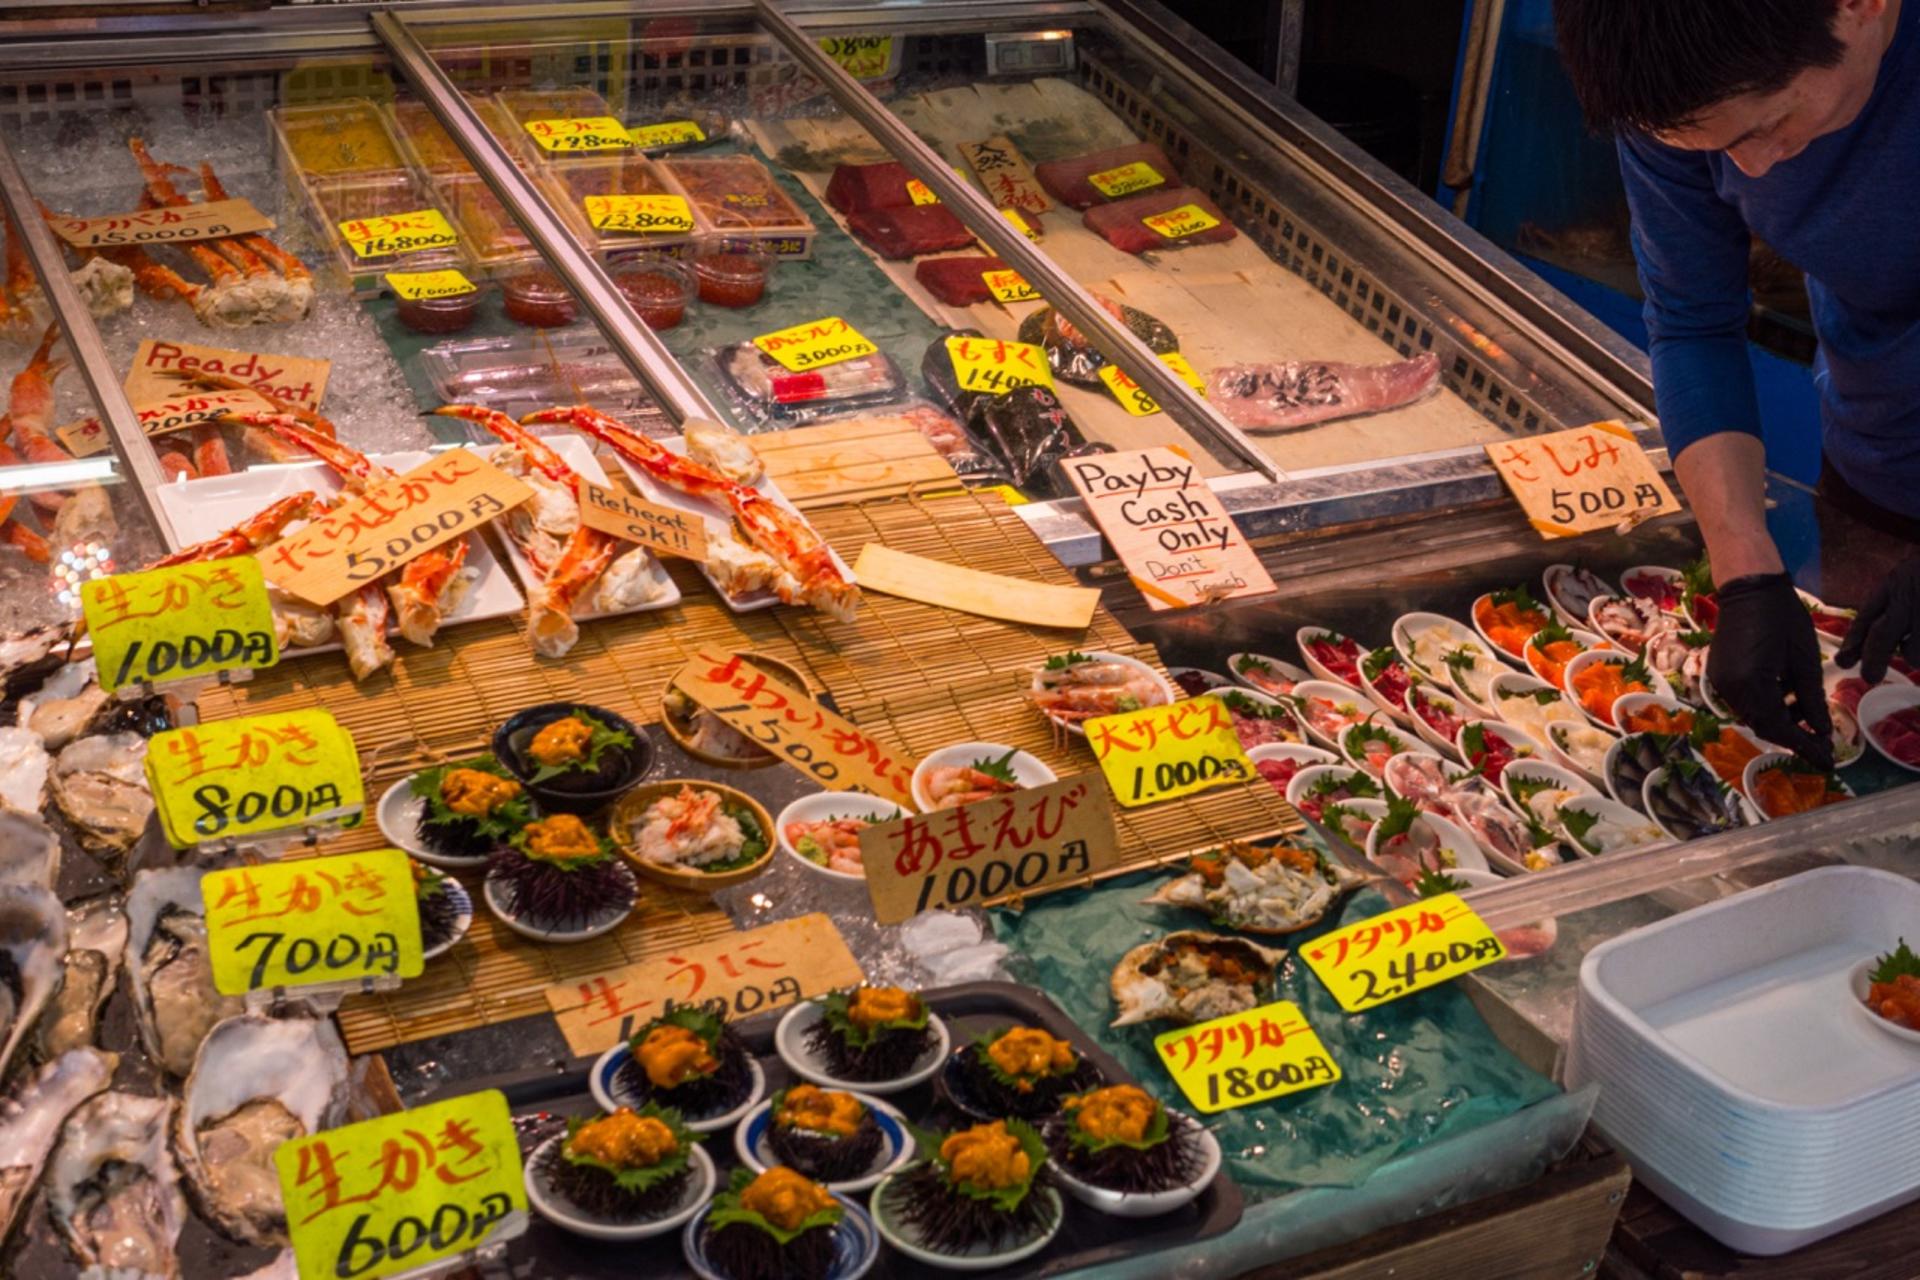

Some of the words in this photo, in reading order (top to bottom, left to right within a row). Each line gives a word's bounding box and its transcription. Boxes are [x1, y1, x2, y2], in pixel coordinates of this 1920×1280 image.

[347, 215, 435, 244] 生うに
[145, 341, 284, 384] Ready
[1500, 434, 1620, 481] さしみ
[587, 485, 690, 531] Reheat
[1120, 490, 1209, 526] Cash
[1550, 483, 1663, 524] 500円
[1158, 518, 1230, 551] Only
[1146, 555, 1207, 579] Don't
[1186, 571, 1247, 594] Toch
[94, 567, 247, 632] 生かき
[167, 724, 320, 786] 生かき
[193, 781, 342, 836] 800円
[888, 783, 1088, 878] あまえび
[216, 862, 387, 928] 生かき
[234, 931, 399, 989] 700円
[577, 940, 786, 1027] 生うに
[295, 1118, 492, 1226] 生かき
[334, 1191, 514, 1279] 600円
